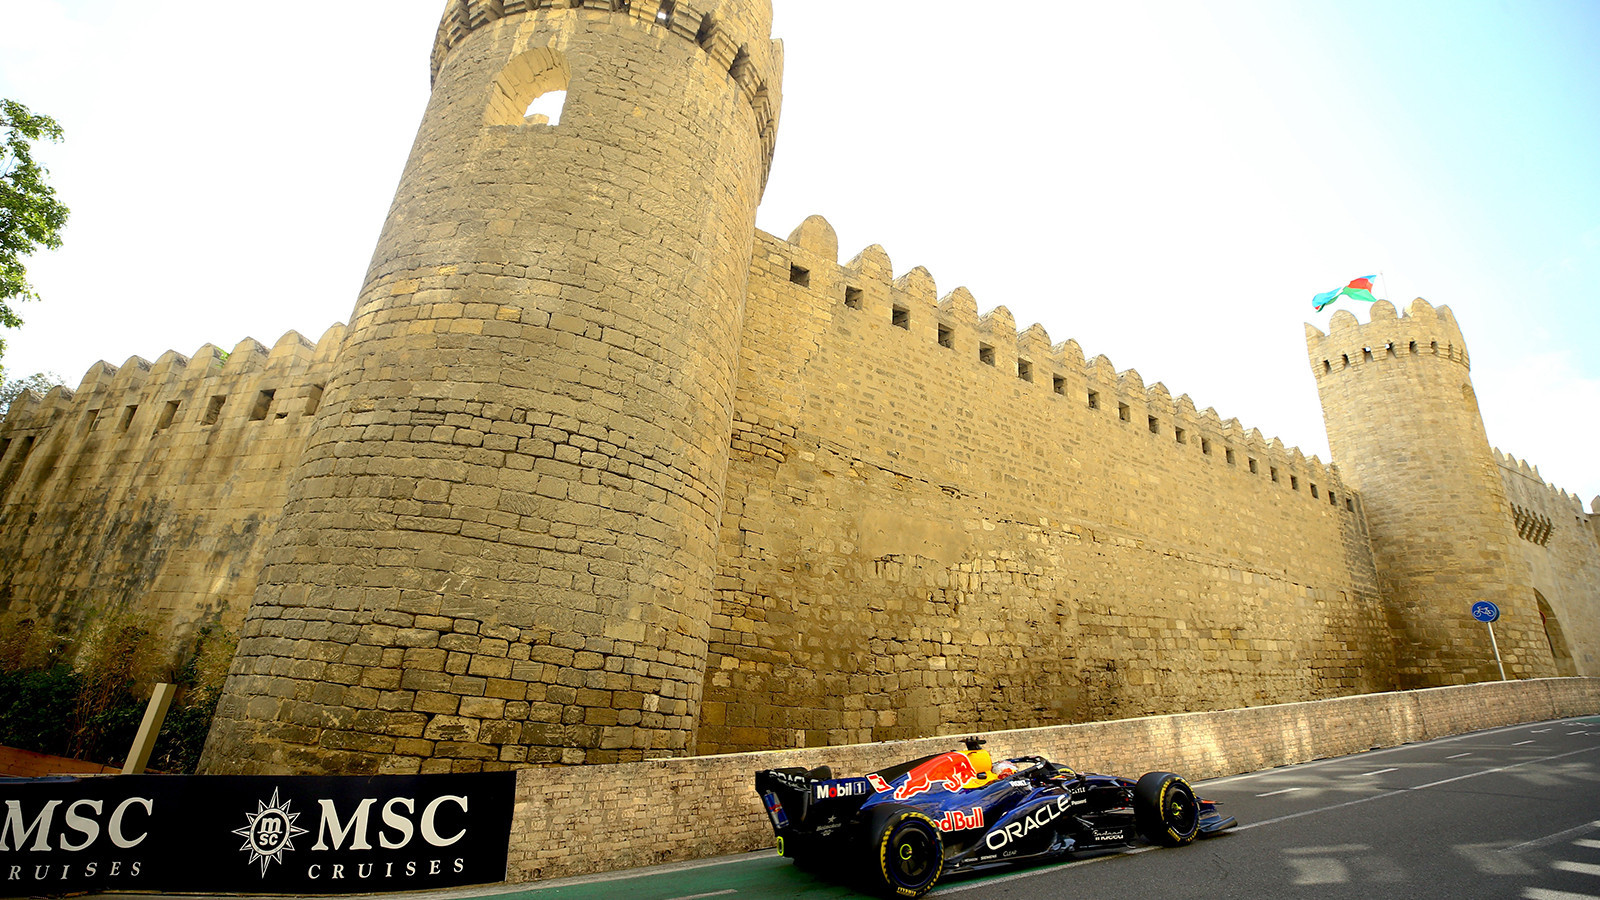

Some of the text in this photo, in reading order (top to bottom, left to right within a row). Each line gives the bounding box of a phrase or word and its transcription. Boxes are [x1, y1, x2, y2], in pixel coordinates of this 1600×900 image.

[816, 782, 852, 799] Mobil
[0, 797, 153, 851] MSC
[311, 795, 468, 850] MSC
[933, 806, 984, 832] ed Bull
[986, 794, 1071, 850] ORACLE
[7, 861, 142, 881] RUISES
[307, 857, 464, 879] CRUISES
